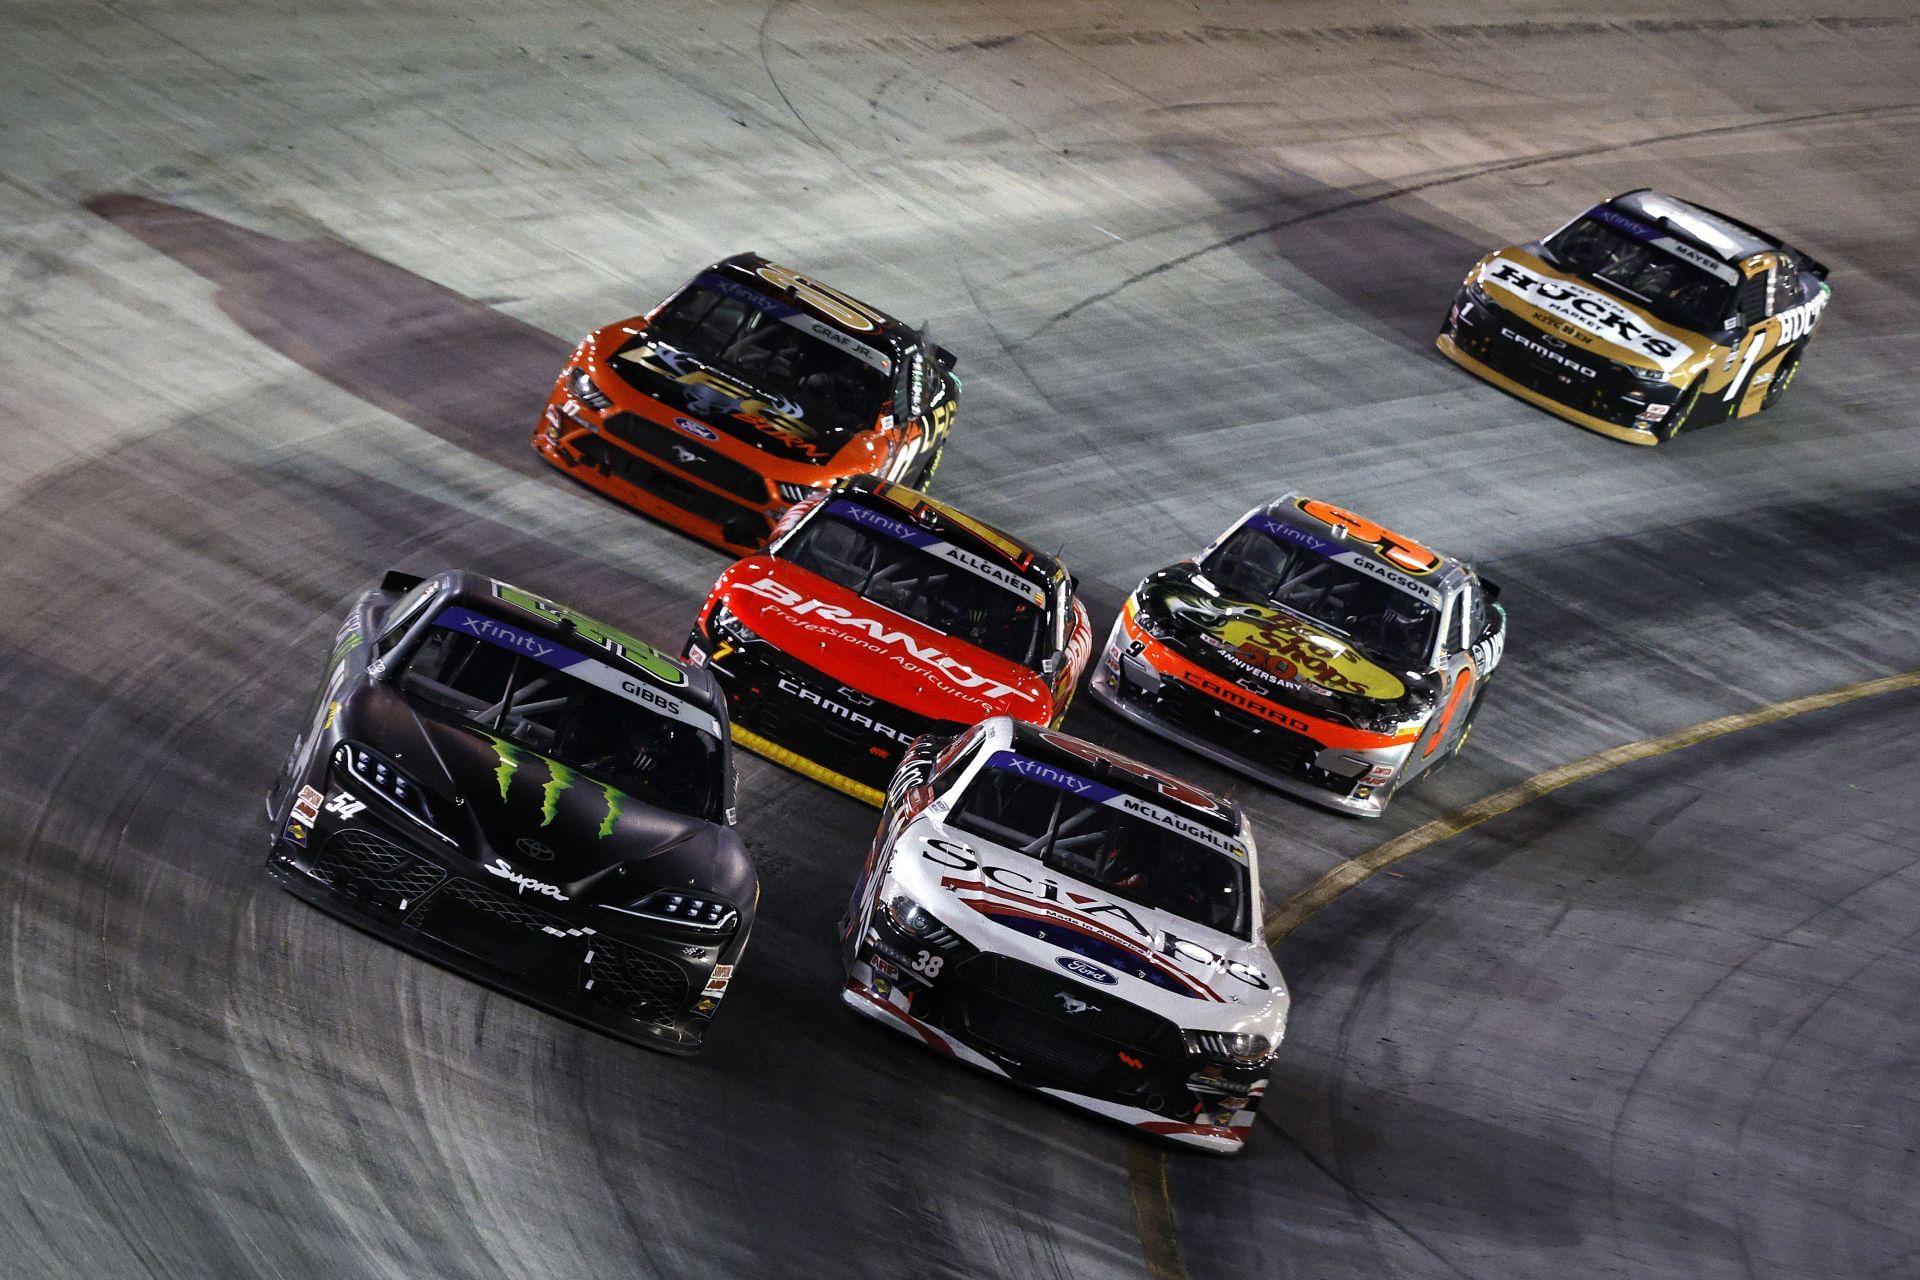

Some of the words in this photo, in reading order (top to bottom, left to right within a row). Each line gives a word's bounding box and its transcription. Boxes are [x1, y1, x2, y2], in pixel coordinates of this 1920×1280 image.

[1602, 209, 1649, 236] xfinity
[1676, 244, 1720, 271] MAYER
[718, 279, 779, 311] xfinity
[1459, 301, 1475, 317] 1
[1490, 264, 1677, 358] HUCK'S
[1548, 302, 1603, 331] MARKET
[811, 323, 852, 347] GRAF
[851, 344, 874, 360] JR.
[1500, 326, 1598, 379] CAMARO
[844, 505, 918, 540] xfinity
[1264, 519, 1327, 549] xfinity
[945, 548, 1033, 596] ALLGAIER
[1352, 556, 1431, 599] GRAGSON
[462, 615, 554, 658] xfinity
[712, 641, 737, 661] 7
[731, 577, 1037, 703] BRANDT
[1126, 640, 1146, 658] 9
[760, 602, 891, 657] Professional
[888, 654, 994, 712] Agriculture
[1217, 649, 1303, 691] ANNIVERSARY
[1235, 641, 1299, 680] 50
[1245, 631, 1370, 695] Shops
[621, 680, 682, 716] GIBBS
[1182, 671, 1310, 733] CAMARO
[1009, 757, 1092, 793] xfinity
[325, 791, 368, 821] 54
[483, 858, 570, 901] Supra
[1045, 909, 1080, 925] Made
[1081, 921, 1094, 932] in
[870, 954, 898, 977] ARP
[911, 949, 945, 979] 38
